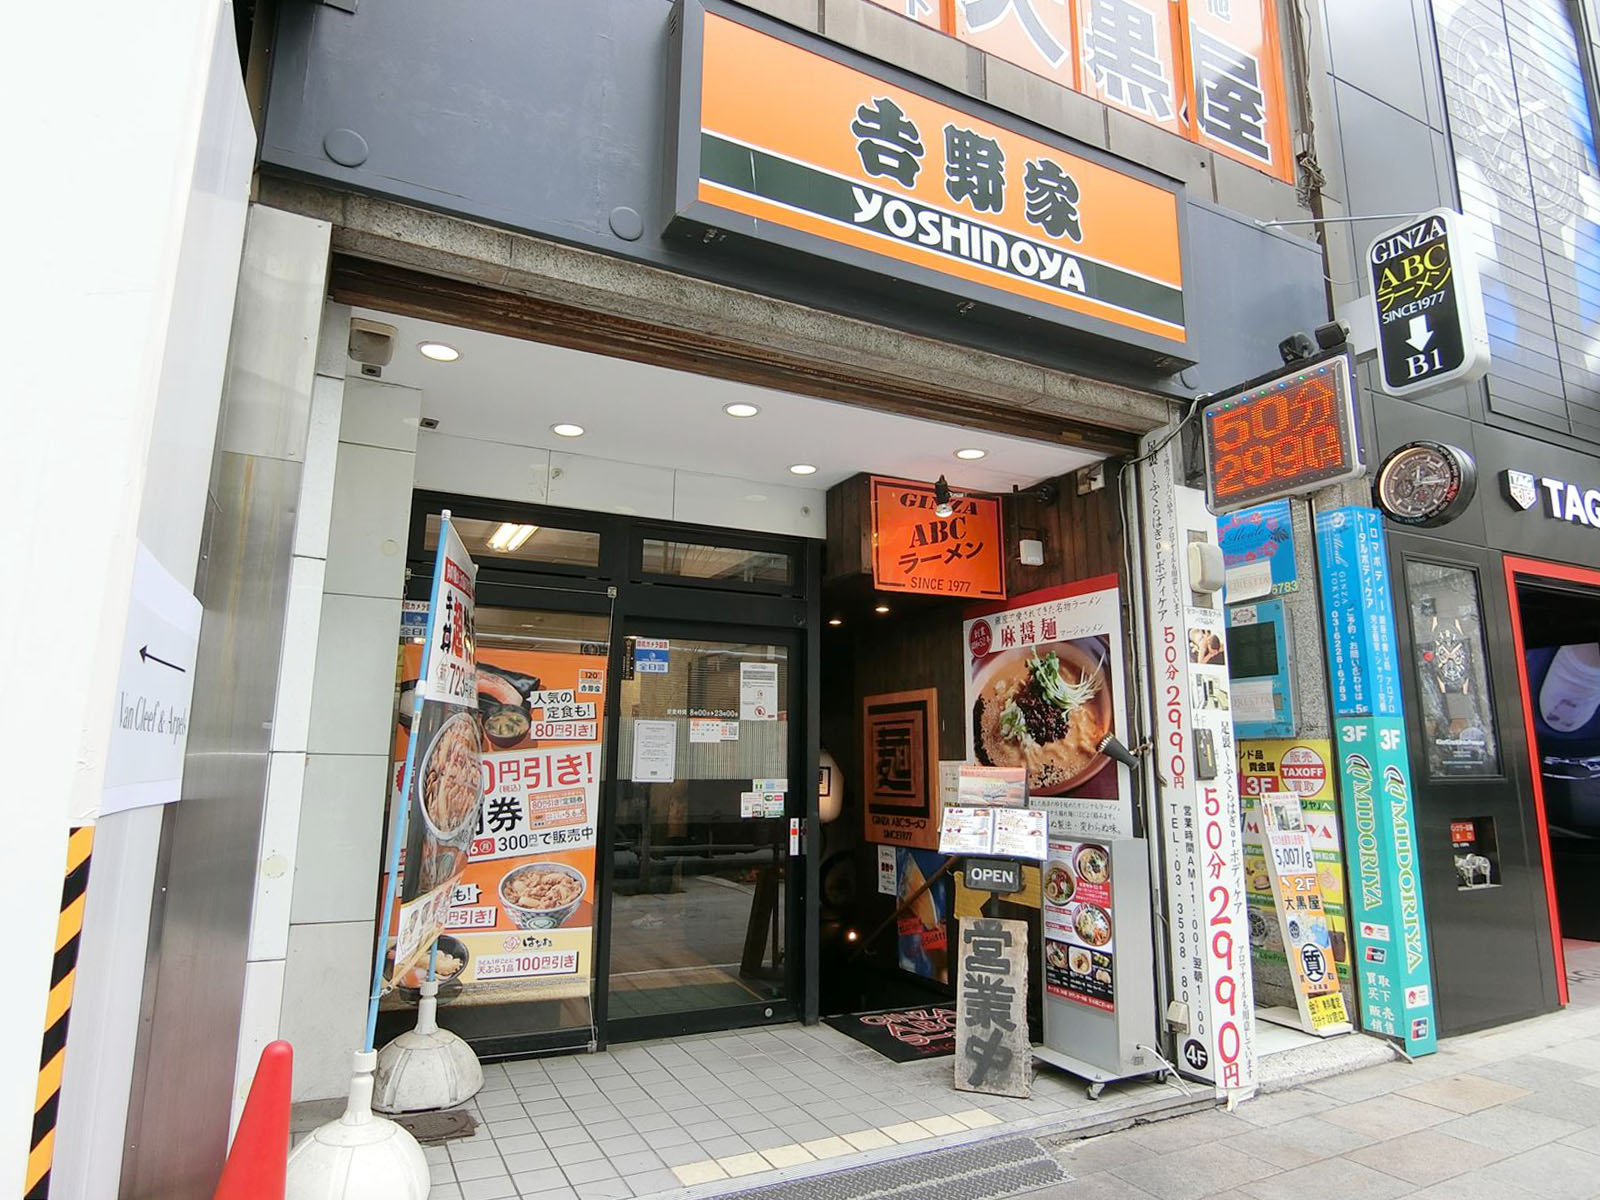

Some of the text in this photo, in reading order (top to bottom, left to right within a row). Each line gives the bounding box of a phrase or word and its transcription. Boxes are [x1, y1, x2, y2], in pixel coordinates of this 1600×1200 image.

[852, 185, 1086, 293] YOSHINOYA
[1371, 216, 1447, 265] GINZA
[1377, 242, 1449, 292] ABC
[1376, 267, 1452, 312] ラーメン
[1407, 349, 1444, 380] B1
[1213, 377, 1334, 452] 50分
[909, 516, 967, 549] ABC
[898, 541, 984, 575] ラーメン
[910, 576, 971, 592] SINCE 1977
[533, 690, 573, 706] 人気の
[134, 696, 160, 733] Cleef
[158, 710, 165, 734] &
[546, 704, 591, 720] 定食も!
[534, 723, 594, 738] 80円引き!
[1341, 725, 1368, 742] 3F
[1379, 728, 1401, 750] 3F
[1249, 762, 1276, 773] 貴金属
[1281, 766, 1323, 778] TAXOFF
[1246, 777, 1272, 794] 3F
[498, 827, 594, 852] 300円で販売中
[1352, 779, 1383, 911] MIDORIYA
[971, 867, 1015, 884] OPEN
[1295, 878, 1316, 891] 2F
[1389, 800, 1424, 974] MIDORIYA
[1284, 896, 1321, 911] 大黒屋
[515, 954, 575, 972] 100円引き
[963, 919, 1018, 1088] 営業中
[1185, 1044, 1207, 1067] 4F
